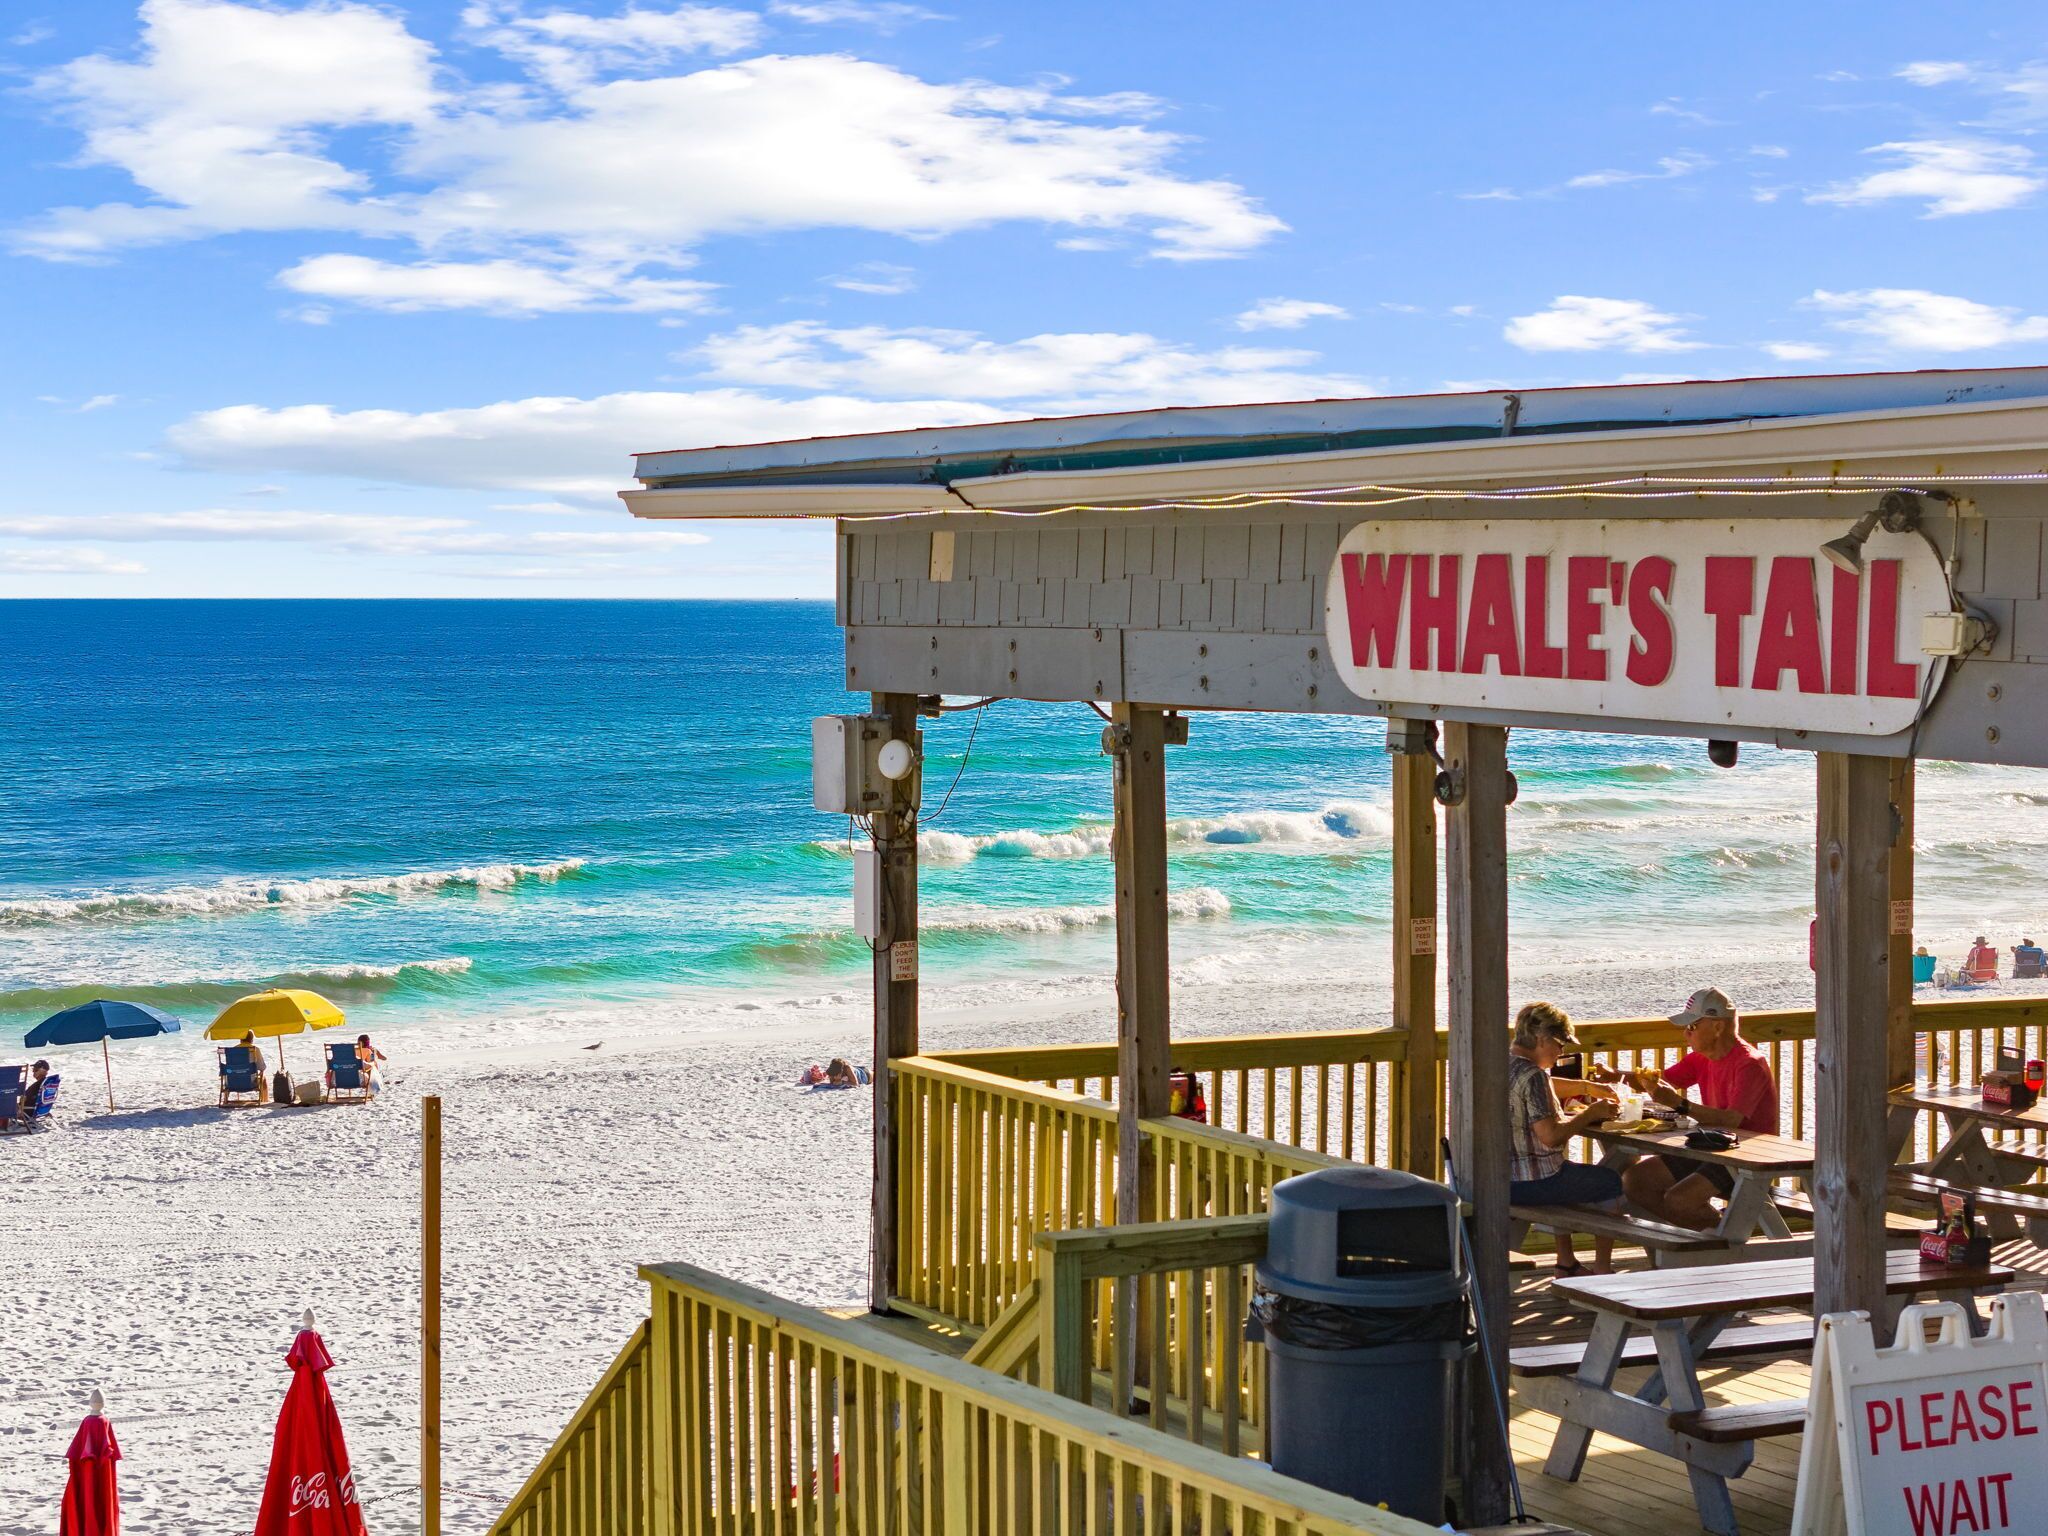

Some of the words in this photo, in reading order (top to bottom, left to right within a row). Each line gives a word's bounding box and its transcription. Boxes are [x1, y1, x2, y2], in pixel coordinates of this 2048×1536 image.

[1341, 553, 1676, 688] WHALE'S
[1704, 556, 1921, 699] TAIL
[895, 972, 915, 980] BIRDS
[1865, 1381, 2039, 1456] PLEASE
[1902, 1472, 2013, 1536] WAIT
